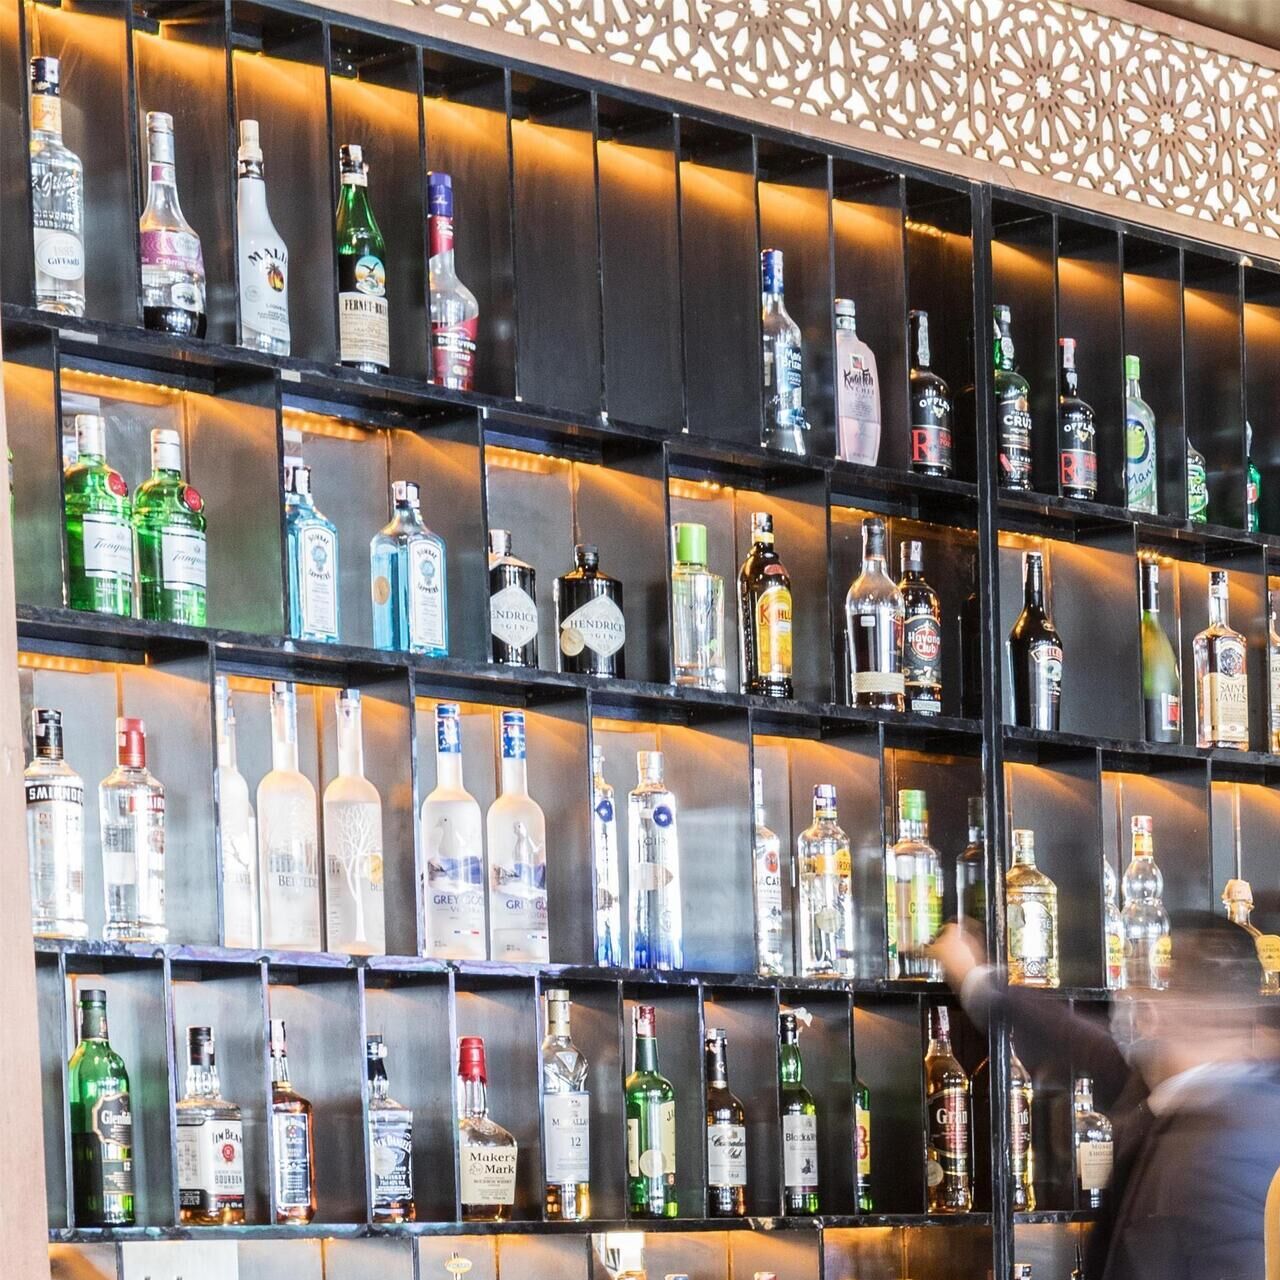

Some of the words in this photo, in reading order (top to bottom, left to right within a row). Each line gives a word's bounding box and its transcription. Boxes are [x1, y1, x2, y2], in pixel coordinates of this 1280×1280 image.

[248, 248, 288, 266] MALI
[907, 631, 941, 646] Havana
[916, 640, 937, 654] Club
[570, 1136, 582, 1147] 12
[470, 1152, 516, 1163] Maker's
[485, 1164, 515, 1174] Mark
